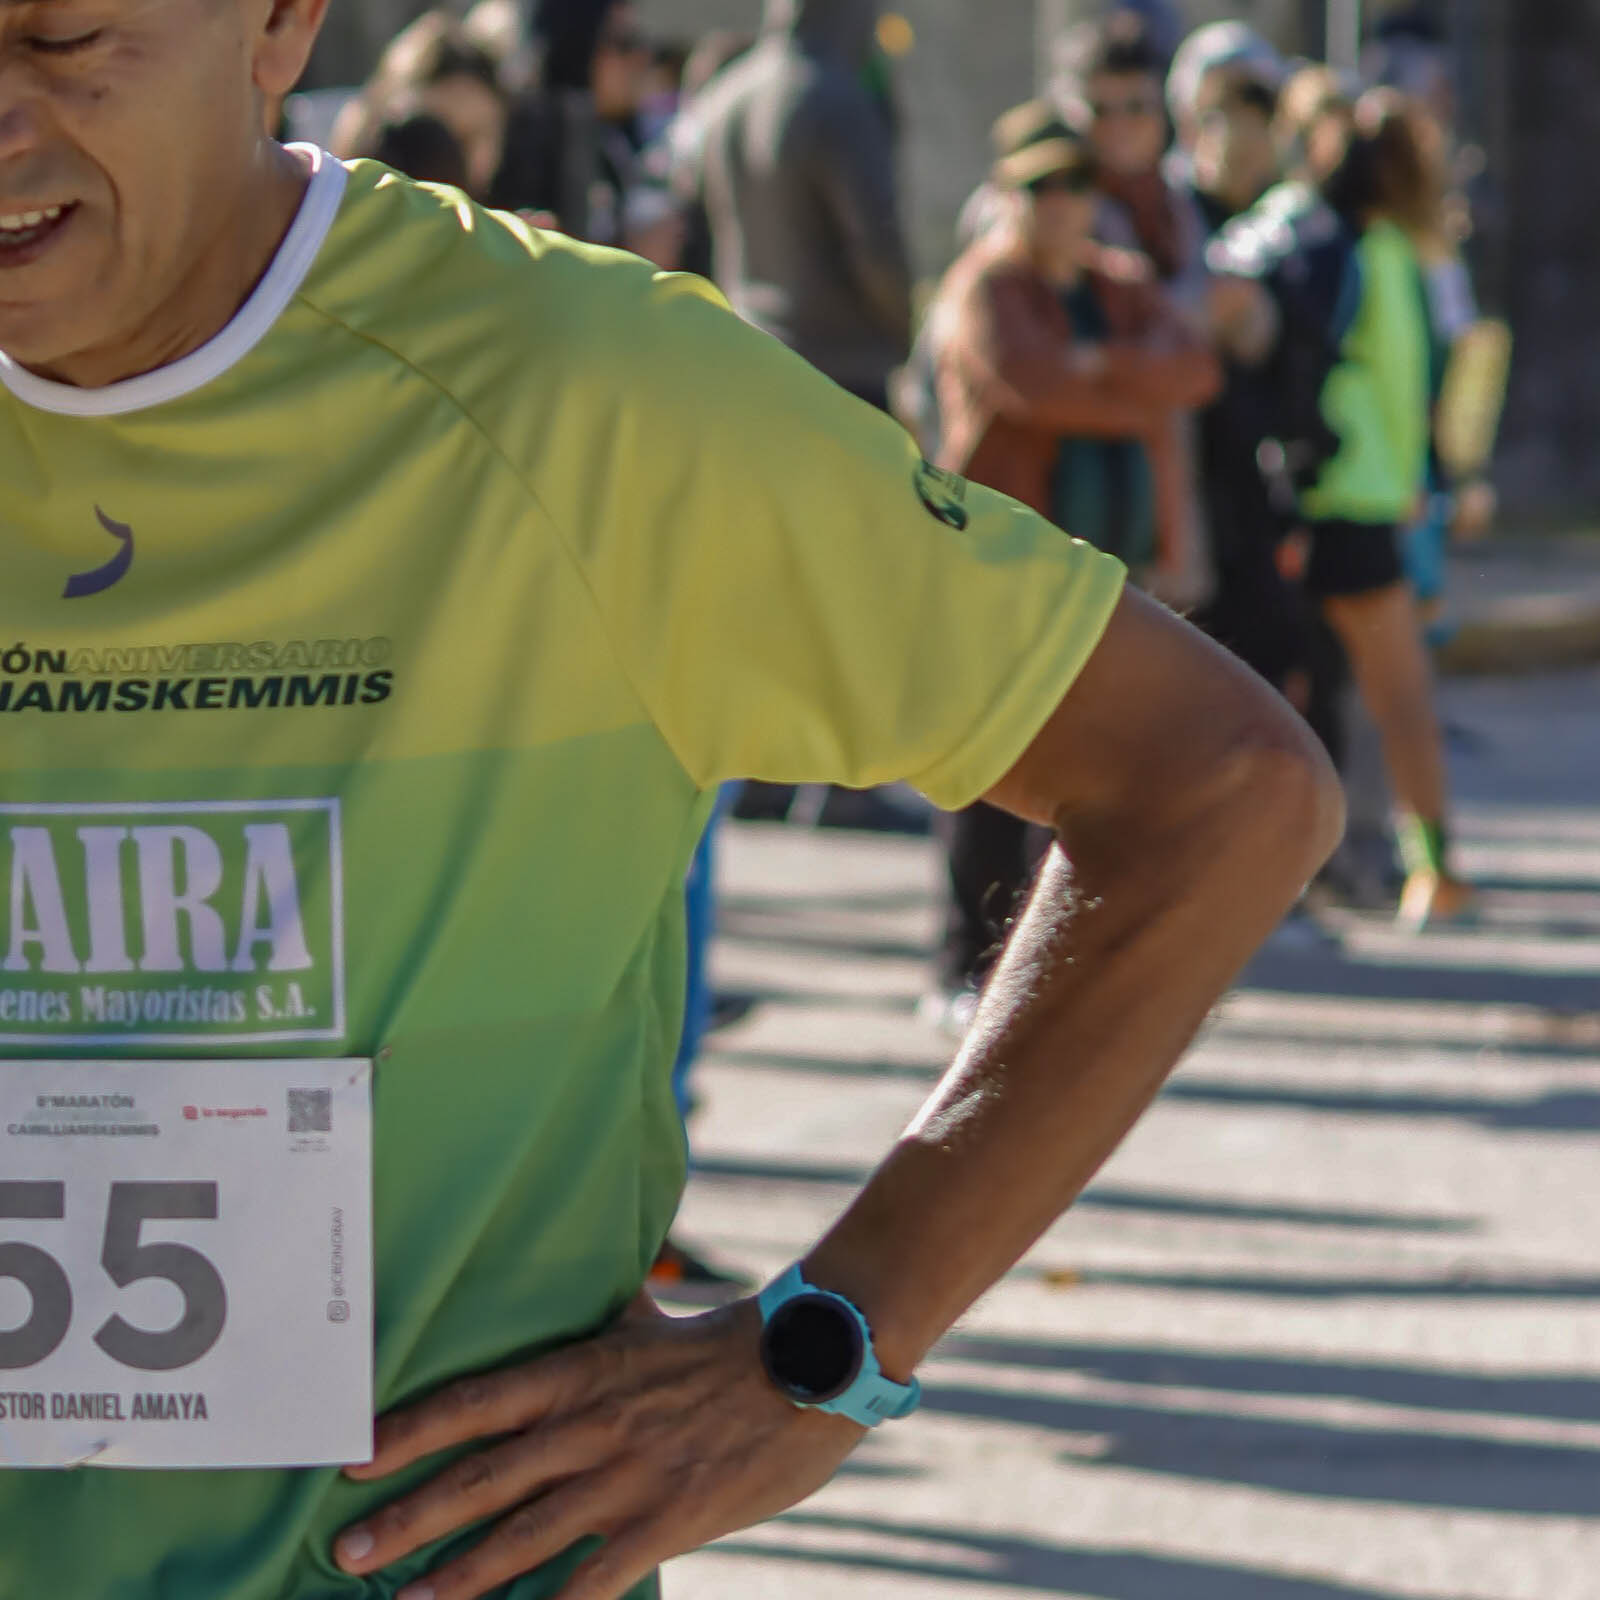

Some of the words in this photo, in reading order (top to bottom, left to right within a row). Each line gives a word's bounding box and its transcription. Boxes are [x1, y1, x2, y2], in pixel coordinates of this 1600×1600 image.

[80, 985, 246, 1027] Mayoristas
[255, 982, 318, 1020] S.A.
[52, 1391, 126, 1420] DANIEL
[131, 1391, 209, 1420] AMAYA
